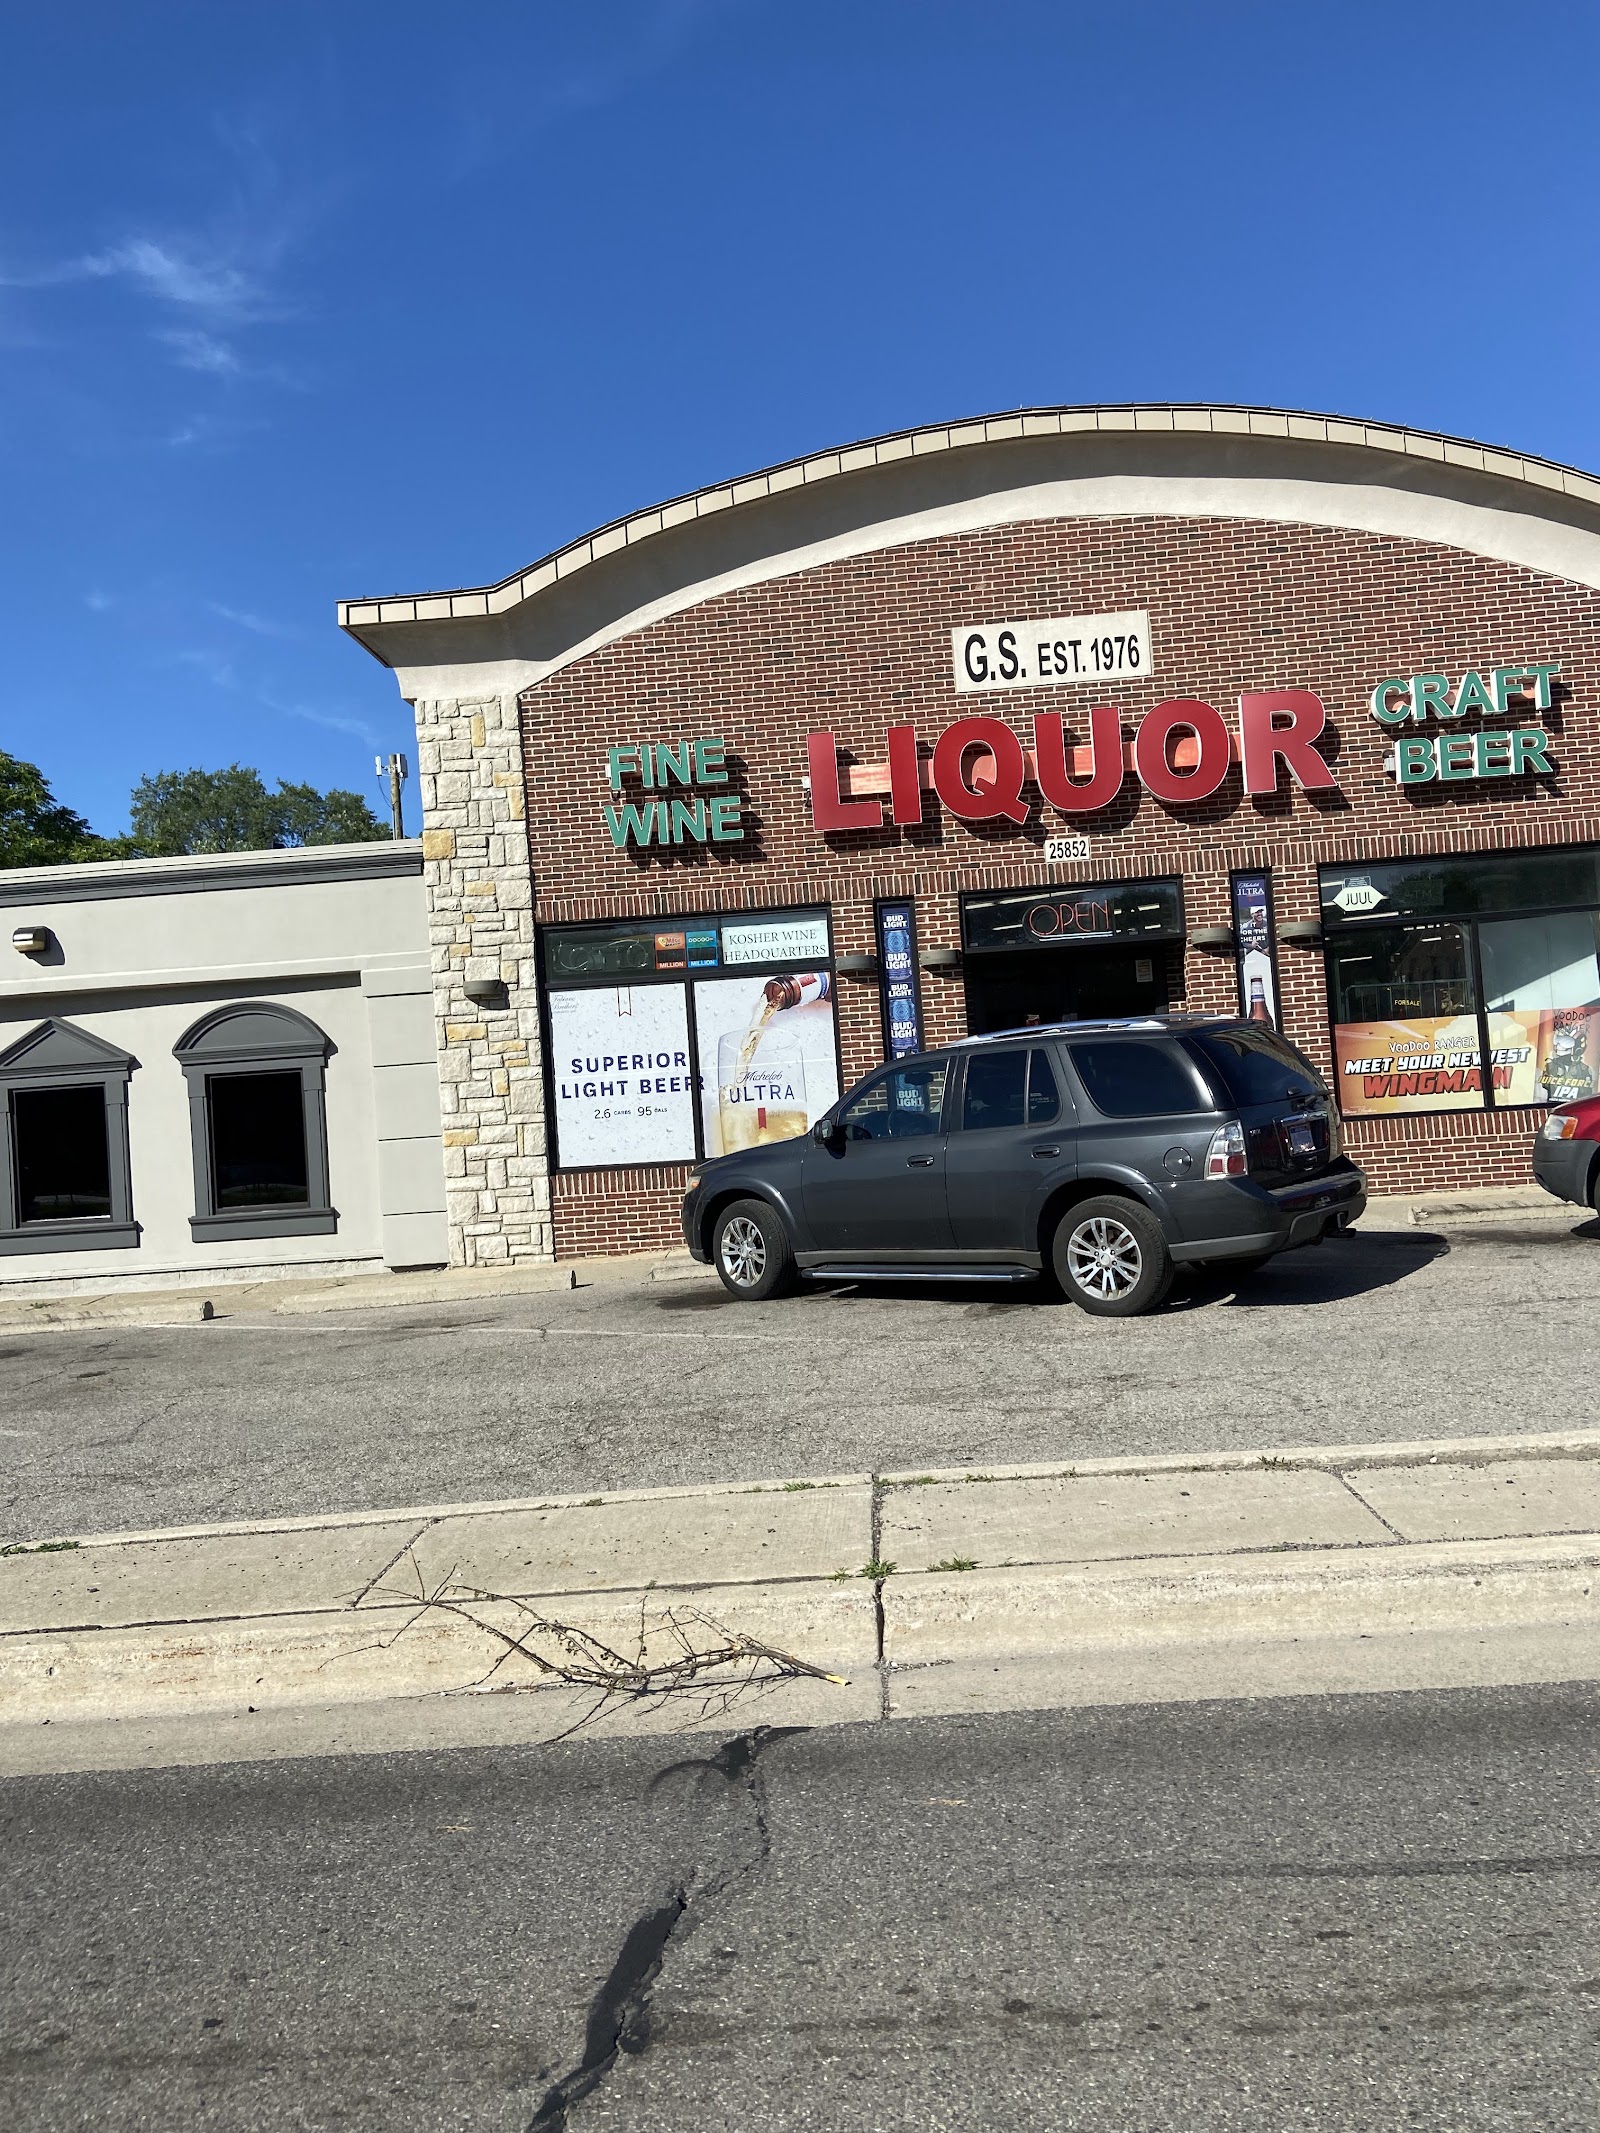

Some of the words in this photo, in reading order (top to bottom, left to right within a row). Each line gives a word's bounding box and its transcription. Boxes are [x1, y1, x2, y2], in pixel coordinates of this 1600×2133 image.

[964, 631, 1026, 682] G.S.
[1038, 640, 1087, 676] EST.
[1090, 635, 1140, 672] 1976
[1370, 664, 1560, 724] CRAFT
[807, 689, 1338, 831] LIQUOR
[1395, 729, 1553, 784] BEER
[608, 738, 729, 791] FINE
[603, 796, 744, 847] WINE
[1049, 840, 1087, 859] 25852
[1345, 892, 1373, 906] JUUL
[883, 921, 907, 929] LIGHT
[1029, 900, 1109, 935] OPEN
[729, 932, 779, 945] KOSHER
[782, 929, 817, 941] WINE
[724, 945, 826, 961] HEADQUARTERS
[887, 953, 908, 961] BUD
[659, 961, 684, 969] MILLION
[690, 959, 715, 967] MILLION
[885, 959, 911, 970] LIGHT
[888, 989, 912, 997] LIGHT
[890, 983, 908, 991] BUD
[1553, 1009, 1591, 1022] VOODOO
[891, 1028, 916, 1038] LIGHT
[893, 1021, 913, 1030] BUD
[1389, 1040, 1430, 1053] VOODOO
[1434, 1036, 1476, 1049] RANGER
[571, 1052, 686, 1073] SUPERIOR
[1344, 1056, 1393, 1075] MEET
[1397, 1053, 1445, 1071] YOUR
[736, 1070, 783, 1084] Michelob
[1363, 1065, 1513, 1098] WINGMAN
[561, 1080, 628, 1099] LIGHT
[729, 1085, 795, 1103] ULTRA
[898, 1090, 919, 1099] BUD
[1553, 1086, 1579, 1099] IPA
[896, 1097, 923, 1107] LIGHT
[594, 1108, 611, 1119] 2.6
[637, 1106, 652, 1116] 95
